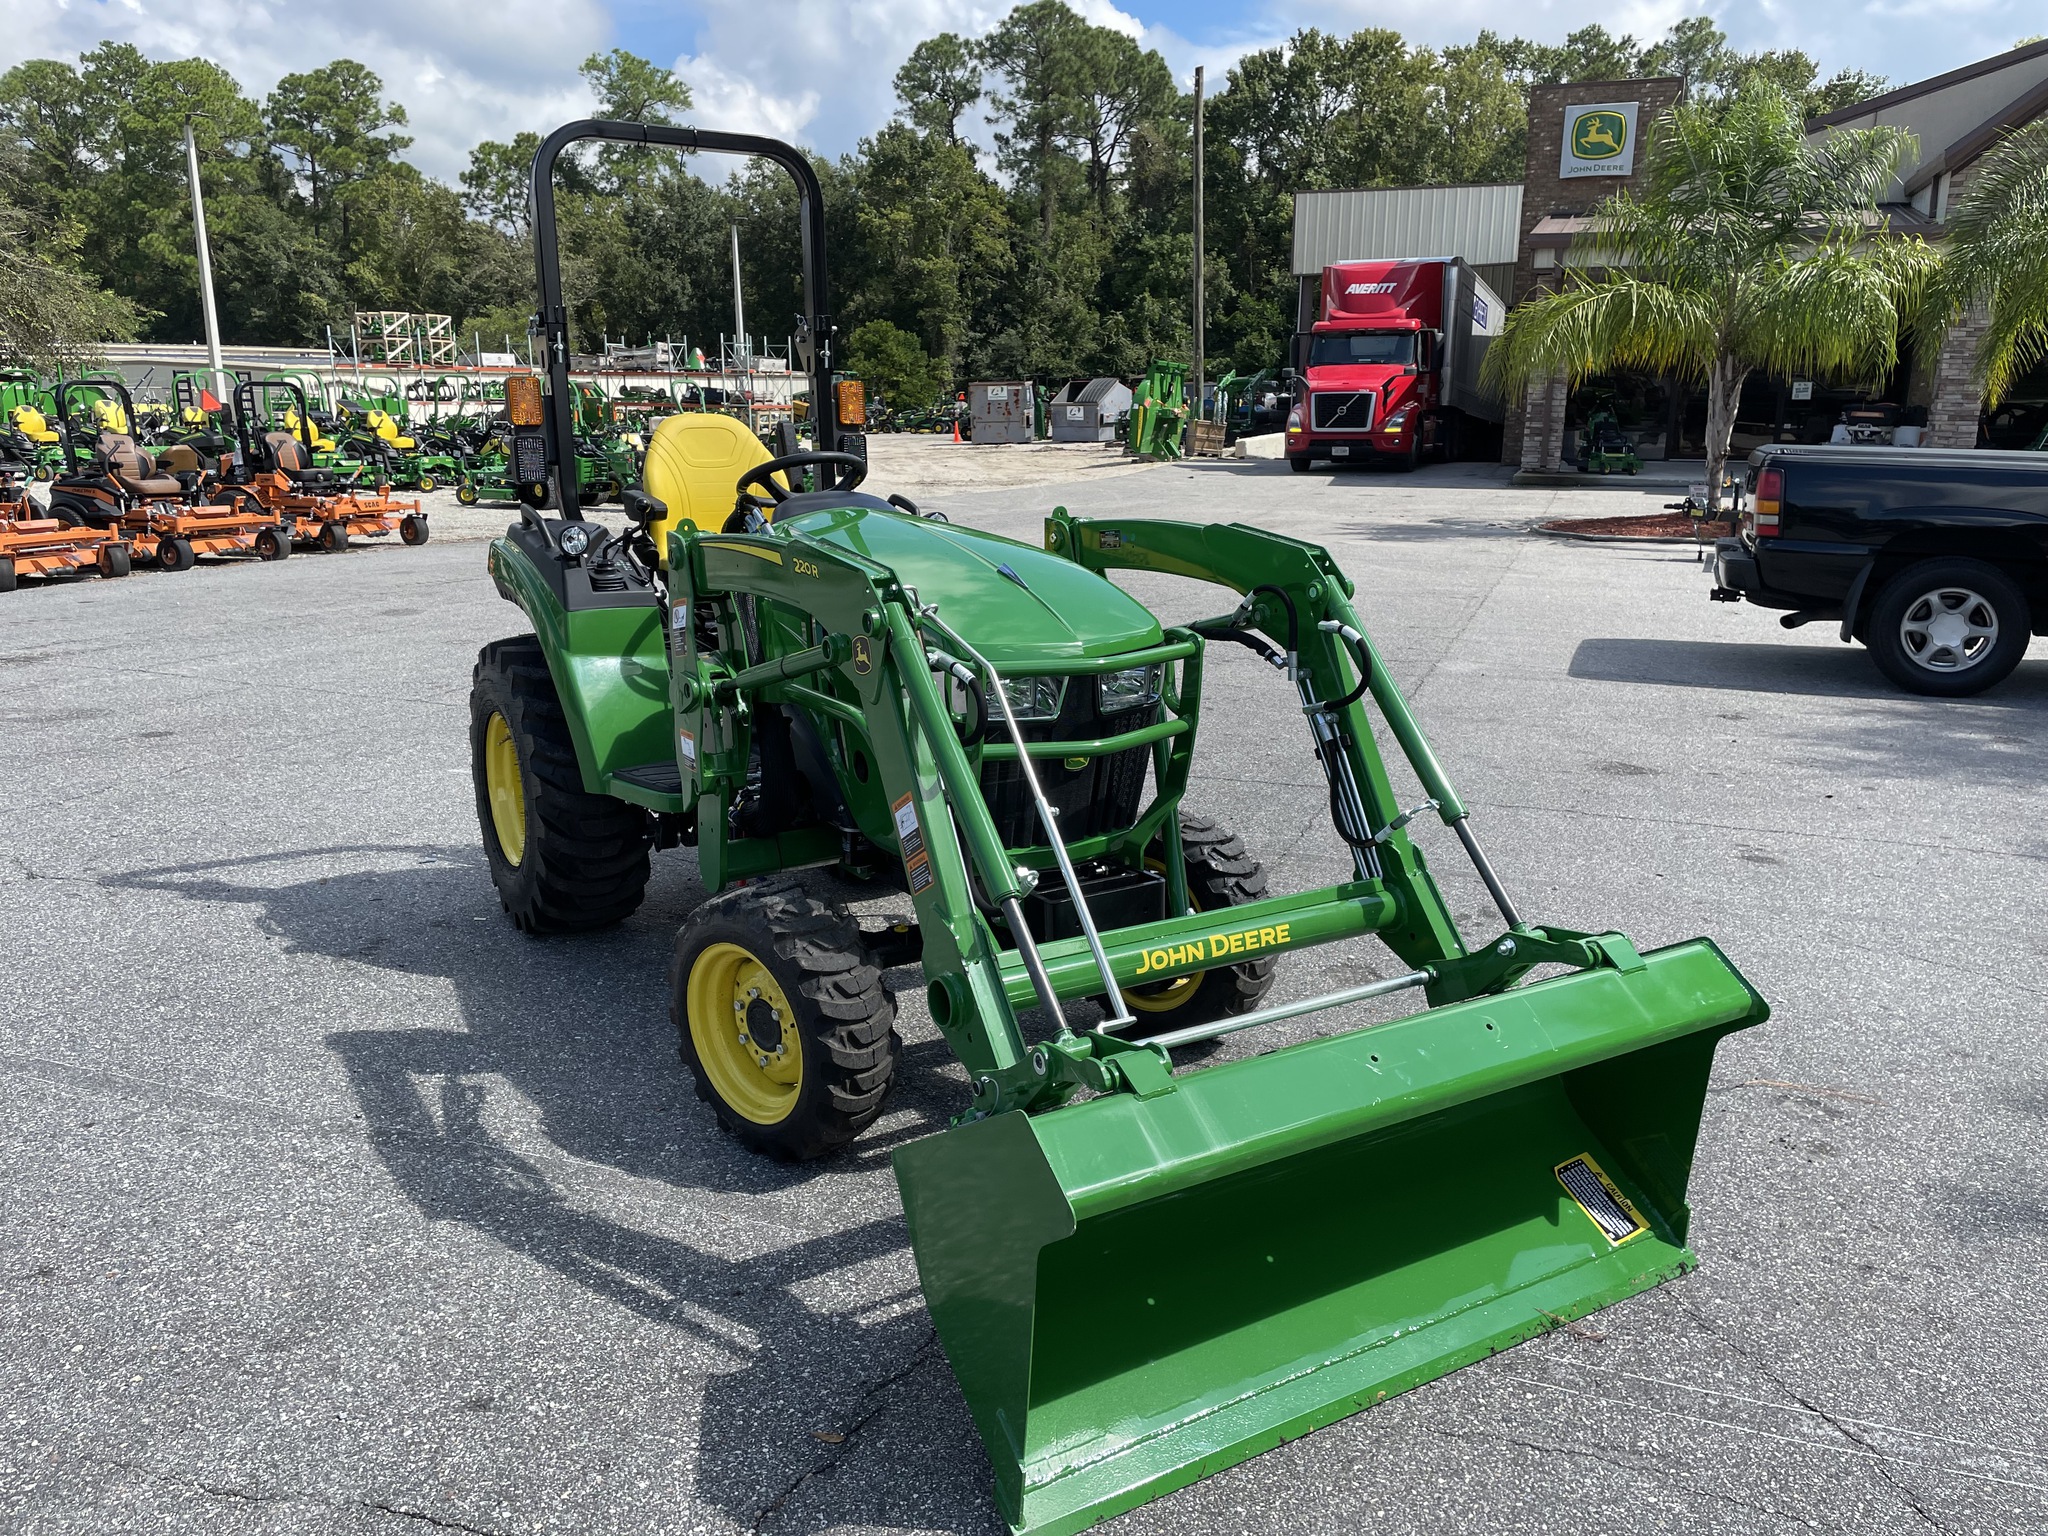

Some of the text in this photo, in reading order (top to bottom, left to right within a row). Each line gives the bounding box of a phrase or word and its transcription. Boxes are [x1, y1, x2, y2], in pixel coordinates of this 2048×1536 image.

[1568, 164, 1625, 174] JOHN DEERE
[1344, 282, 1398, 295] AVERITT
[792, 557, 819, 579] 220R
[1135, 923, 1292, 975] JOHN DEERE
[1606, 1182, 1634, 1213] CAUTION
